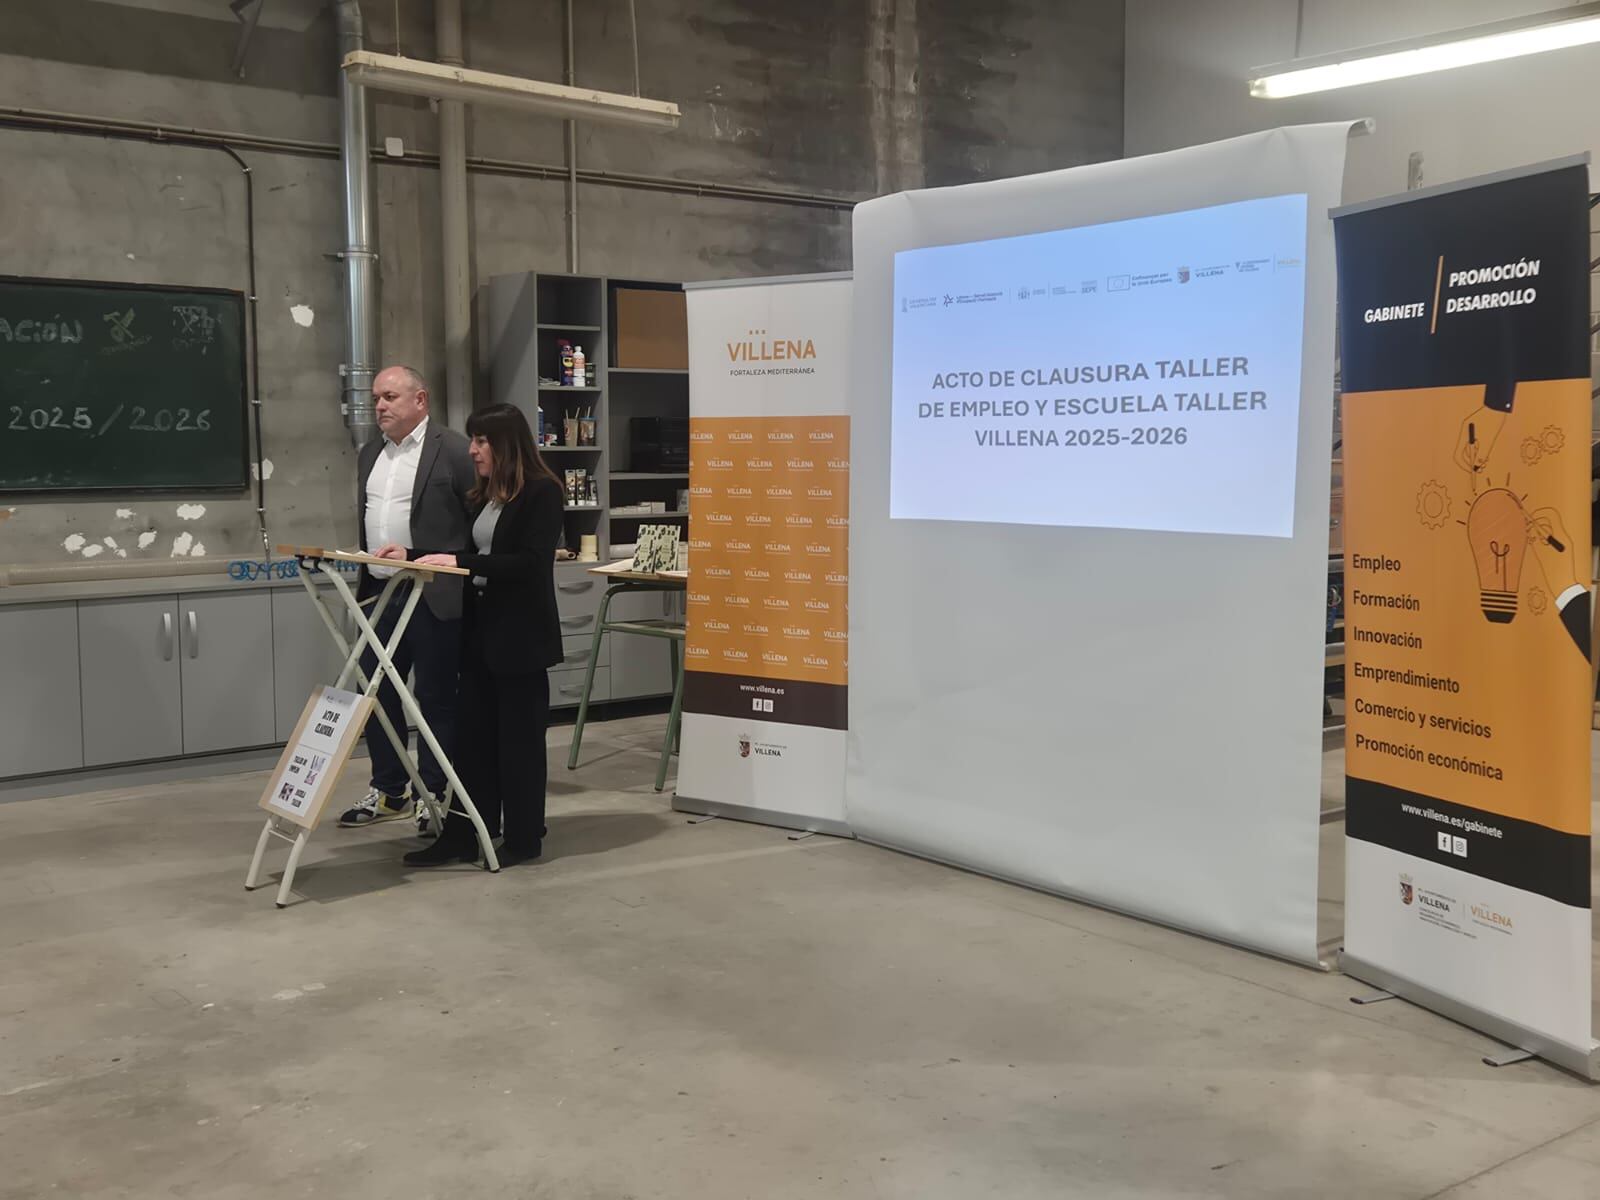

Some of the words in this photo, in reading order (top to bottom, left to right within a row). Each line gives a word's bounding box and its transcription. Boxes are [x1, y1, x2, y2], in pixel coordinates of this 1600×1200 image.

[1448, 257, 1540, 287] PROMOCIÓN
[1446, 288, 1536, 314] DESARROLLO
[1364, 302, 1425, 323] GABINETE
[727, 339, 817, 362] VILLENA
[730, 369, 766, 377] FORTALEZA
[767, 367, 815, 376] MEDITERRÁNEA
[932, 371, 984, 389] ACTO
[989, 371, 1015, 388] DE
[1020, 362, 1150, 387] CLAUSURA
[1155, 356, 1249, 379] TALLER
[918, 402, 945, 418] DE
[949, 399, 1030, 418] EMPLEO
[1034, 399, 1049, 416] Y
[1053, 393, 1168, 416] ESCUELA
[1173, 390, 1267, 412] TALLER
[728, 432, 753, 440] VILLENA
[768, 432, 794, 440] VILLENA
[809, 432, 833, 440] VILLENA
[974, 430, 1060, 447] VILLENA
[1064, 426, 1188, 447] 2025-2026
[707, 460, 733, 468] VILLENA
[747, 460, 773, 468] VILLENA
[727, 487, 752, 495] VILLENA
[767, 488, 792, 496] VILLENA
[807, 489, 832, 497] VILLENA
[706, 514, 732, 522] VILLENA
[745, 515, 772, 523] VILLENA
[786, 516, 813, 525] VILLENA
[726, 542, 751, 550] VILLENA
[765, 543, 791, 551] VILLENA
[806, 545, 831, 553] VILLENA
[1352, 553, 1401, 573] Empleo
[705, 568, 731, 576] VILLENA
[744, 569, 770, 578] VILLENA
[784, 571, 811, 580] VILLENA
[725, 596, 750, 604] VILLENA
[763, 598, 789, 607] VILLENA
[805, 600, 829, 609] VILLENA
[1353, 590, 1420, 611] Formación
[704, 621, 730, 630] VILLENA
[743, 624, 768, 633] VILLENA
[783, 627, 810, 636] VILLENA
[1353, 626, 1423, 649] Innovación
[723, 649, 748, 659] VILLENA
[762, 652, 788, 662] VILLENA
[803, 656, 829, 666] VILLENA
[1354, 662, 1460, 693] Emprendimiento
[740, 683, 785, 695] www.villena.es
[1355, 698, 1416, 723] Comercio
[1419, 711, 1426, 729] y
[1430, 714, 1492, 738] servicios
[754, 747, 781, 757] VILLENA
[1356, 733, 1424, 763] Promoción
[1428, 751, 1503, 781] económica
[1401, 802, 1503, 839] www.villena.es/gabinete
[1418, 894, 1450, 912] VILLENA
[1470, 904, 1513, 928] VILLENA
